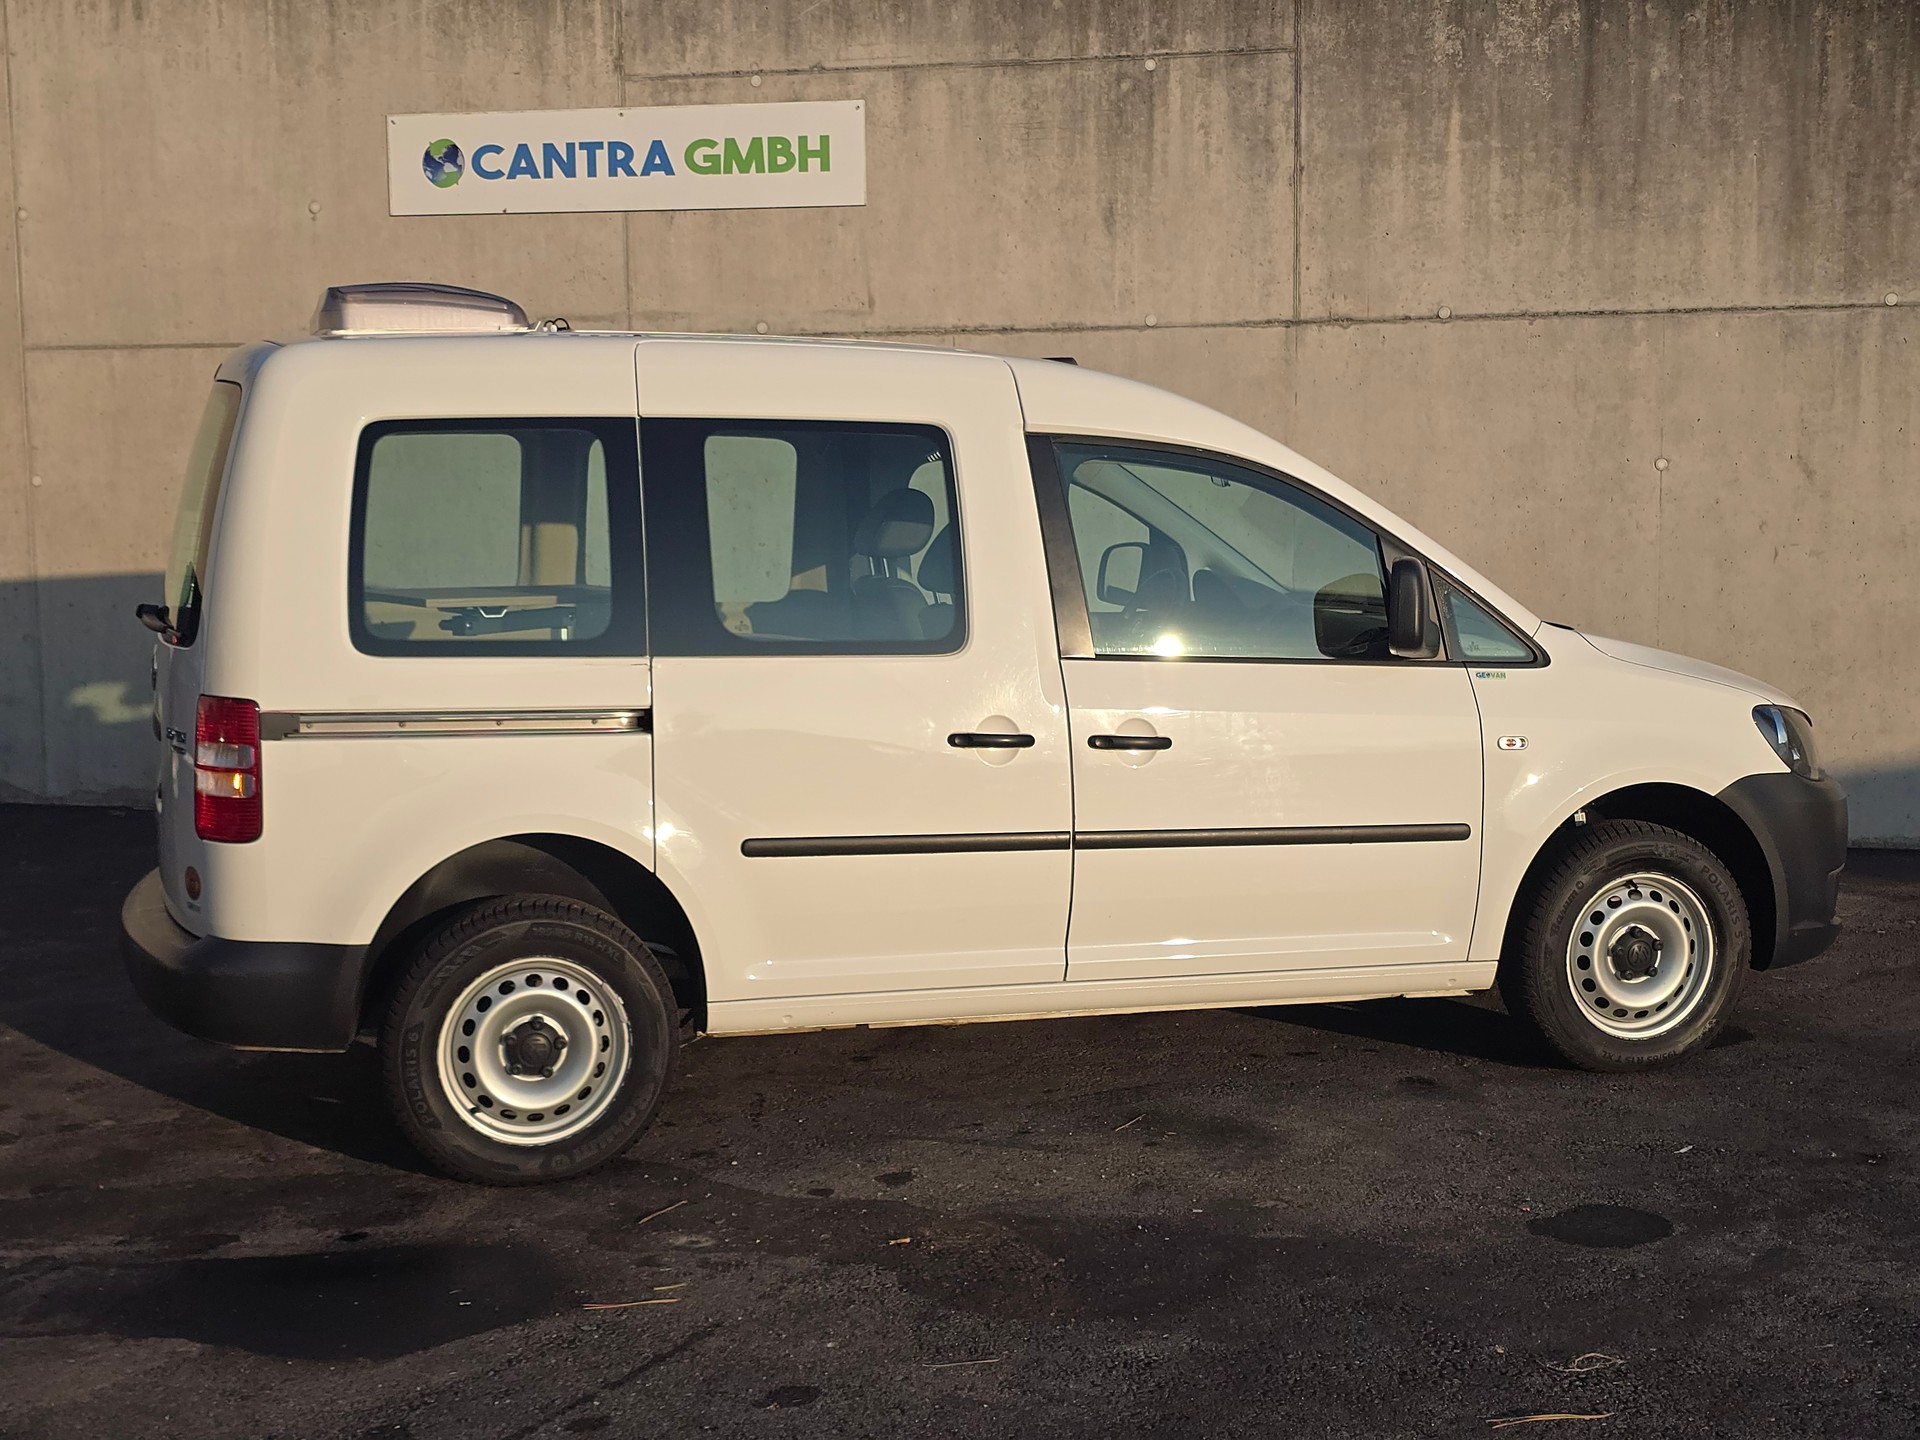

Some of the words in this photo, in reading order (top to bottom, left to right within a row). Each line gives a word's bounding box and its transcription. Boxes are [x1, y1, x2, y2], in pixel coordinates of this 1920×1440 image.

[471, 140, 675, 180] CANTRA
[684, 135, 831, 175] GMBH
[1701, 865, 1740, 925] POLARIS
